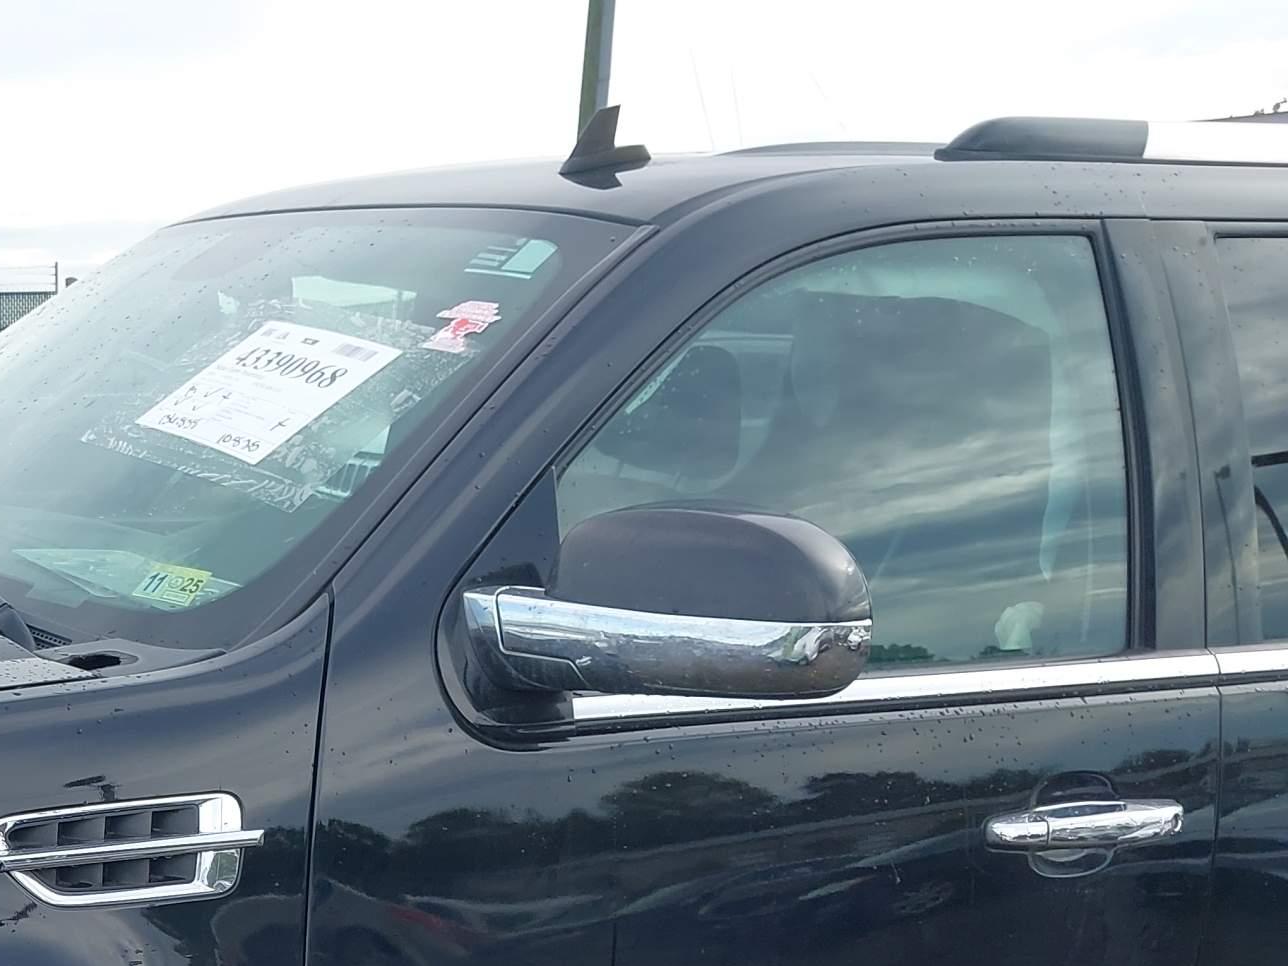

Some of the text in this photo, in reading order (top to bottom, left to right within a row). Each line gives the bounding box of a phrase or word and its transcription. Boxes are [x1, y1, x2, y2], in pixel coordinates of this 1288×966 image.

[235, 346, 349, 389] 43390968
[143, 572, 204, 594] 11 25
